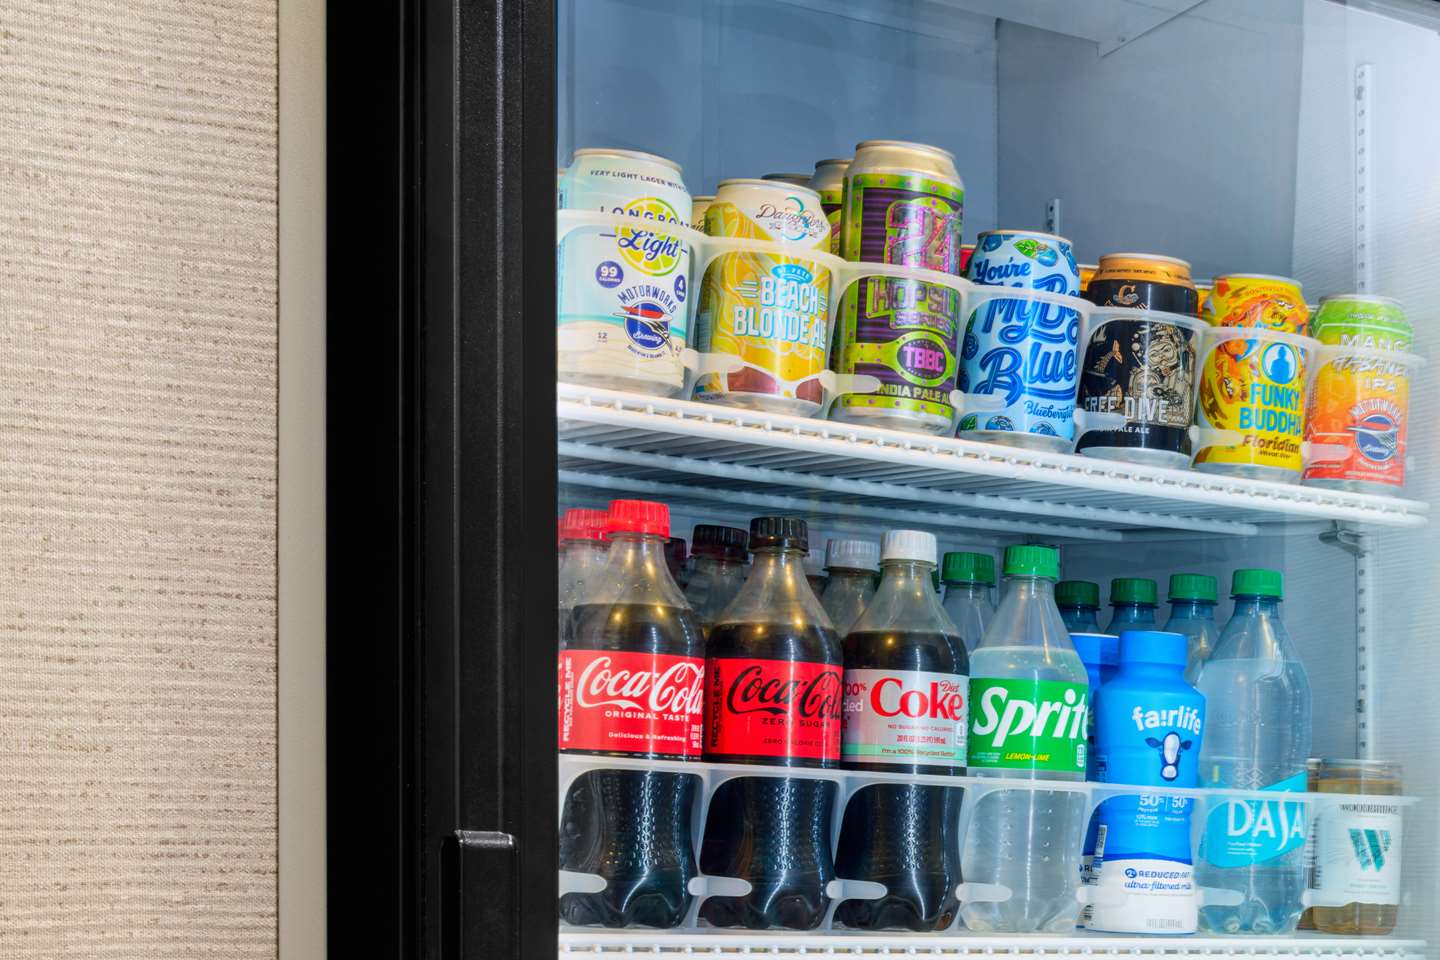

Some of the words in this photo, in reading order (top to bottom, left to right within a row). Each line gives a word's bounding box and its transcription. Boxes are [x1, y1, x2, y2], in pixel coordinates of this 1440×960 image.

[590, 169, 610, 177] VERY
[612, 170, 638, 181] LIGHT
[640, 175, 665, 186] LAGER
[617, 227, 680, 262] Light
[600, 265, 618, 278] 99
[974, 256, 1032, 284] You're
[617, 284, 677, 314] MOTORWORKS
[760, 275, 818, 316] BEACH
[733, 305, 811, 346] BLONDE
[903, 345, 945, 372] TBBC
[974, 341, 1077, 409] Blue
[1363, 377, 1397, 393] IPA
[913, 385, 943, 401] PALE
[1249, 383, 1300, 411] FUNKY
[1123, 396, 1169, 424] DIVE
[1134, 426, 1150, 435] ALE
[576, 656, 705, 715] Coca-Cola
[869, 676, 964, 722] Coke
[939, 680, 960, 694] Diet
[604, 709, 659, 721] ORIGINAL
[662, 712, 690, 723] TASTE
[799, 719, 831, 729] SUGAR
[608, 731, 643, 741] Delicious
[1004, 751, 1050, 762] LEMON-LIME
[1227, 789, 1306, 852] DASA
[1138, 870, 1178, 879] REDUCED
